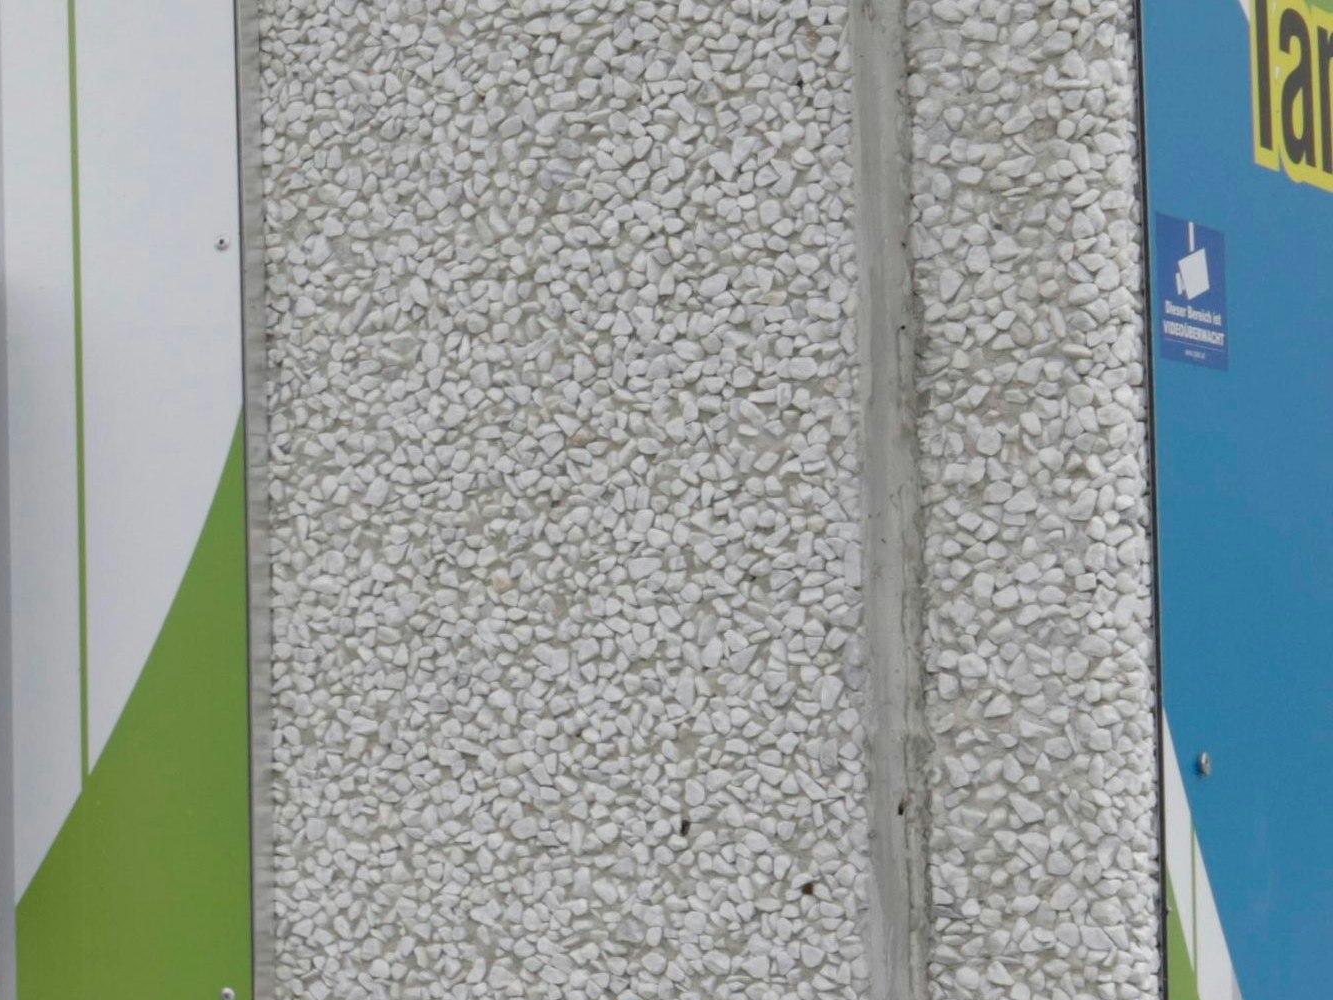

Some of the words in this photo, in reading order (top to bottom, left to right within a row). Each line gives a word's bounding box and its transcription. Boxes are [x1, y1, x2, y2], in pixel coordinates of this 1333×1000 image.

[1164, 299, 1187, 317] Dieser
[1187, 305, 1212, 324] Bereich
[1212, 311, 1222, 326] ist
[1163, 320, 1225, 346] VIDEOÜBERWACHT
